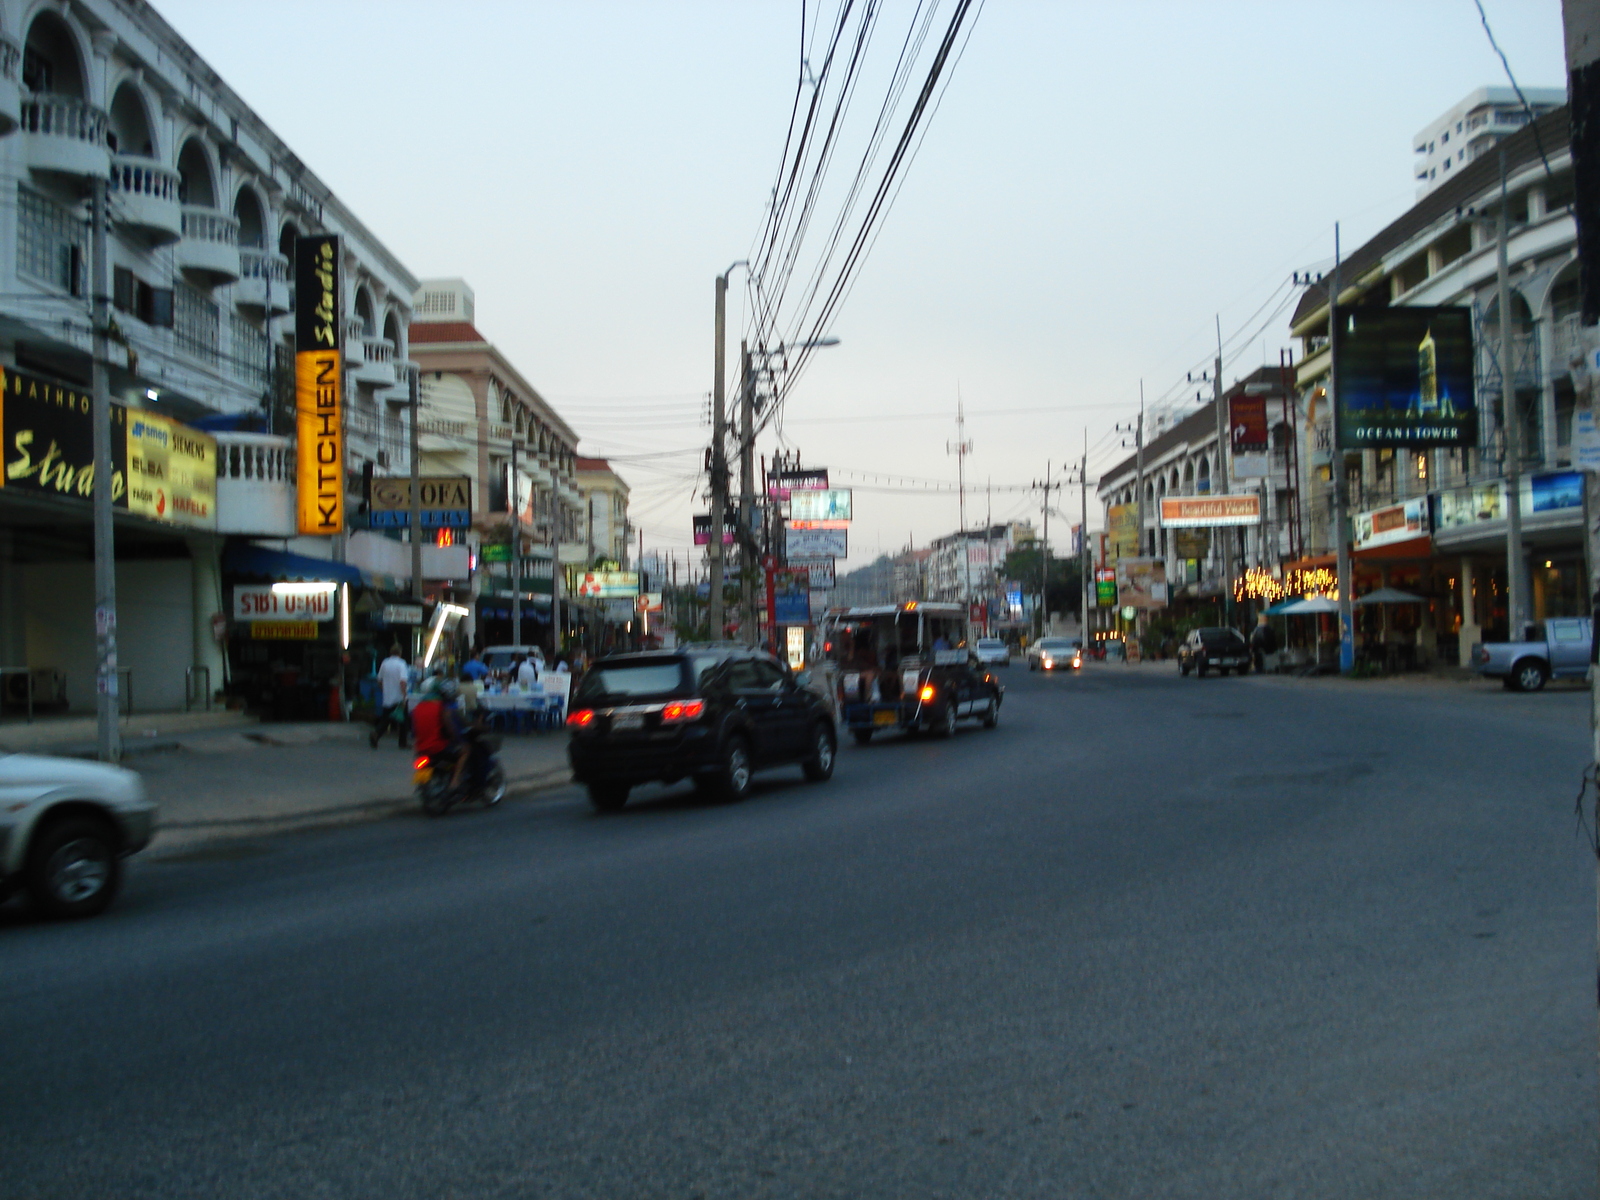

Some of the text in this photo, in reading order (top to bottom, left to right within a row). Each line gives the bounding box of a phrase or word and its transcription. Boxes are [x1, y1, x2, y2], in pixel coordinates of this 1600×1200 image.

[314, 240, 335, 348] Studio
[145, 425, 168, 449] smeg
[316, 358, 337, 529] KITCHEN
[1356, 427, 1402, 440] OCEAN
[1414, 427, 1458, 440] TOWER
[172, 434, 205, 461] SIEMENS
[7, 429, 126, 502] Studo
[132, 456, 164, 480] ELBA
[408, 482, 466, 505] OFA
[374, 511, 464, 524] GALERY
[1181, 499, 1254, 517] Beautiful World
